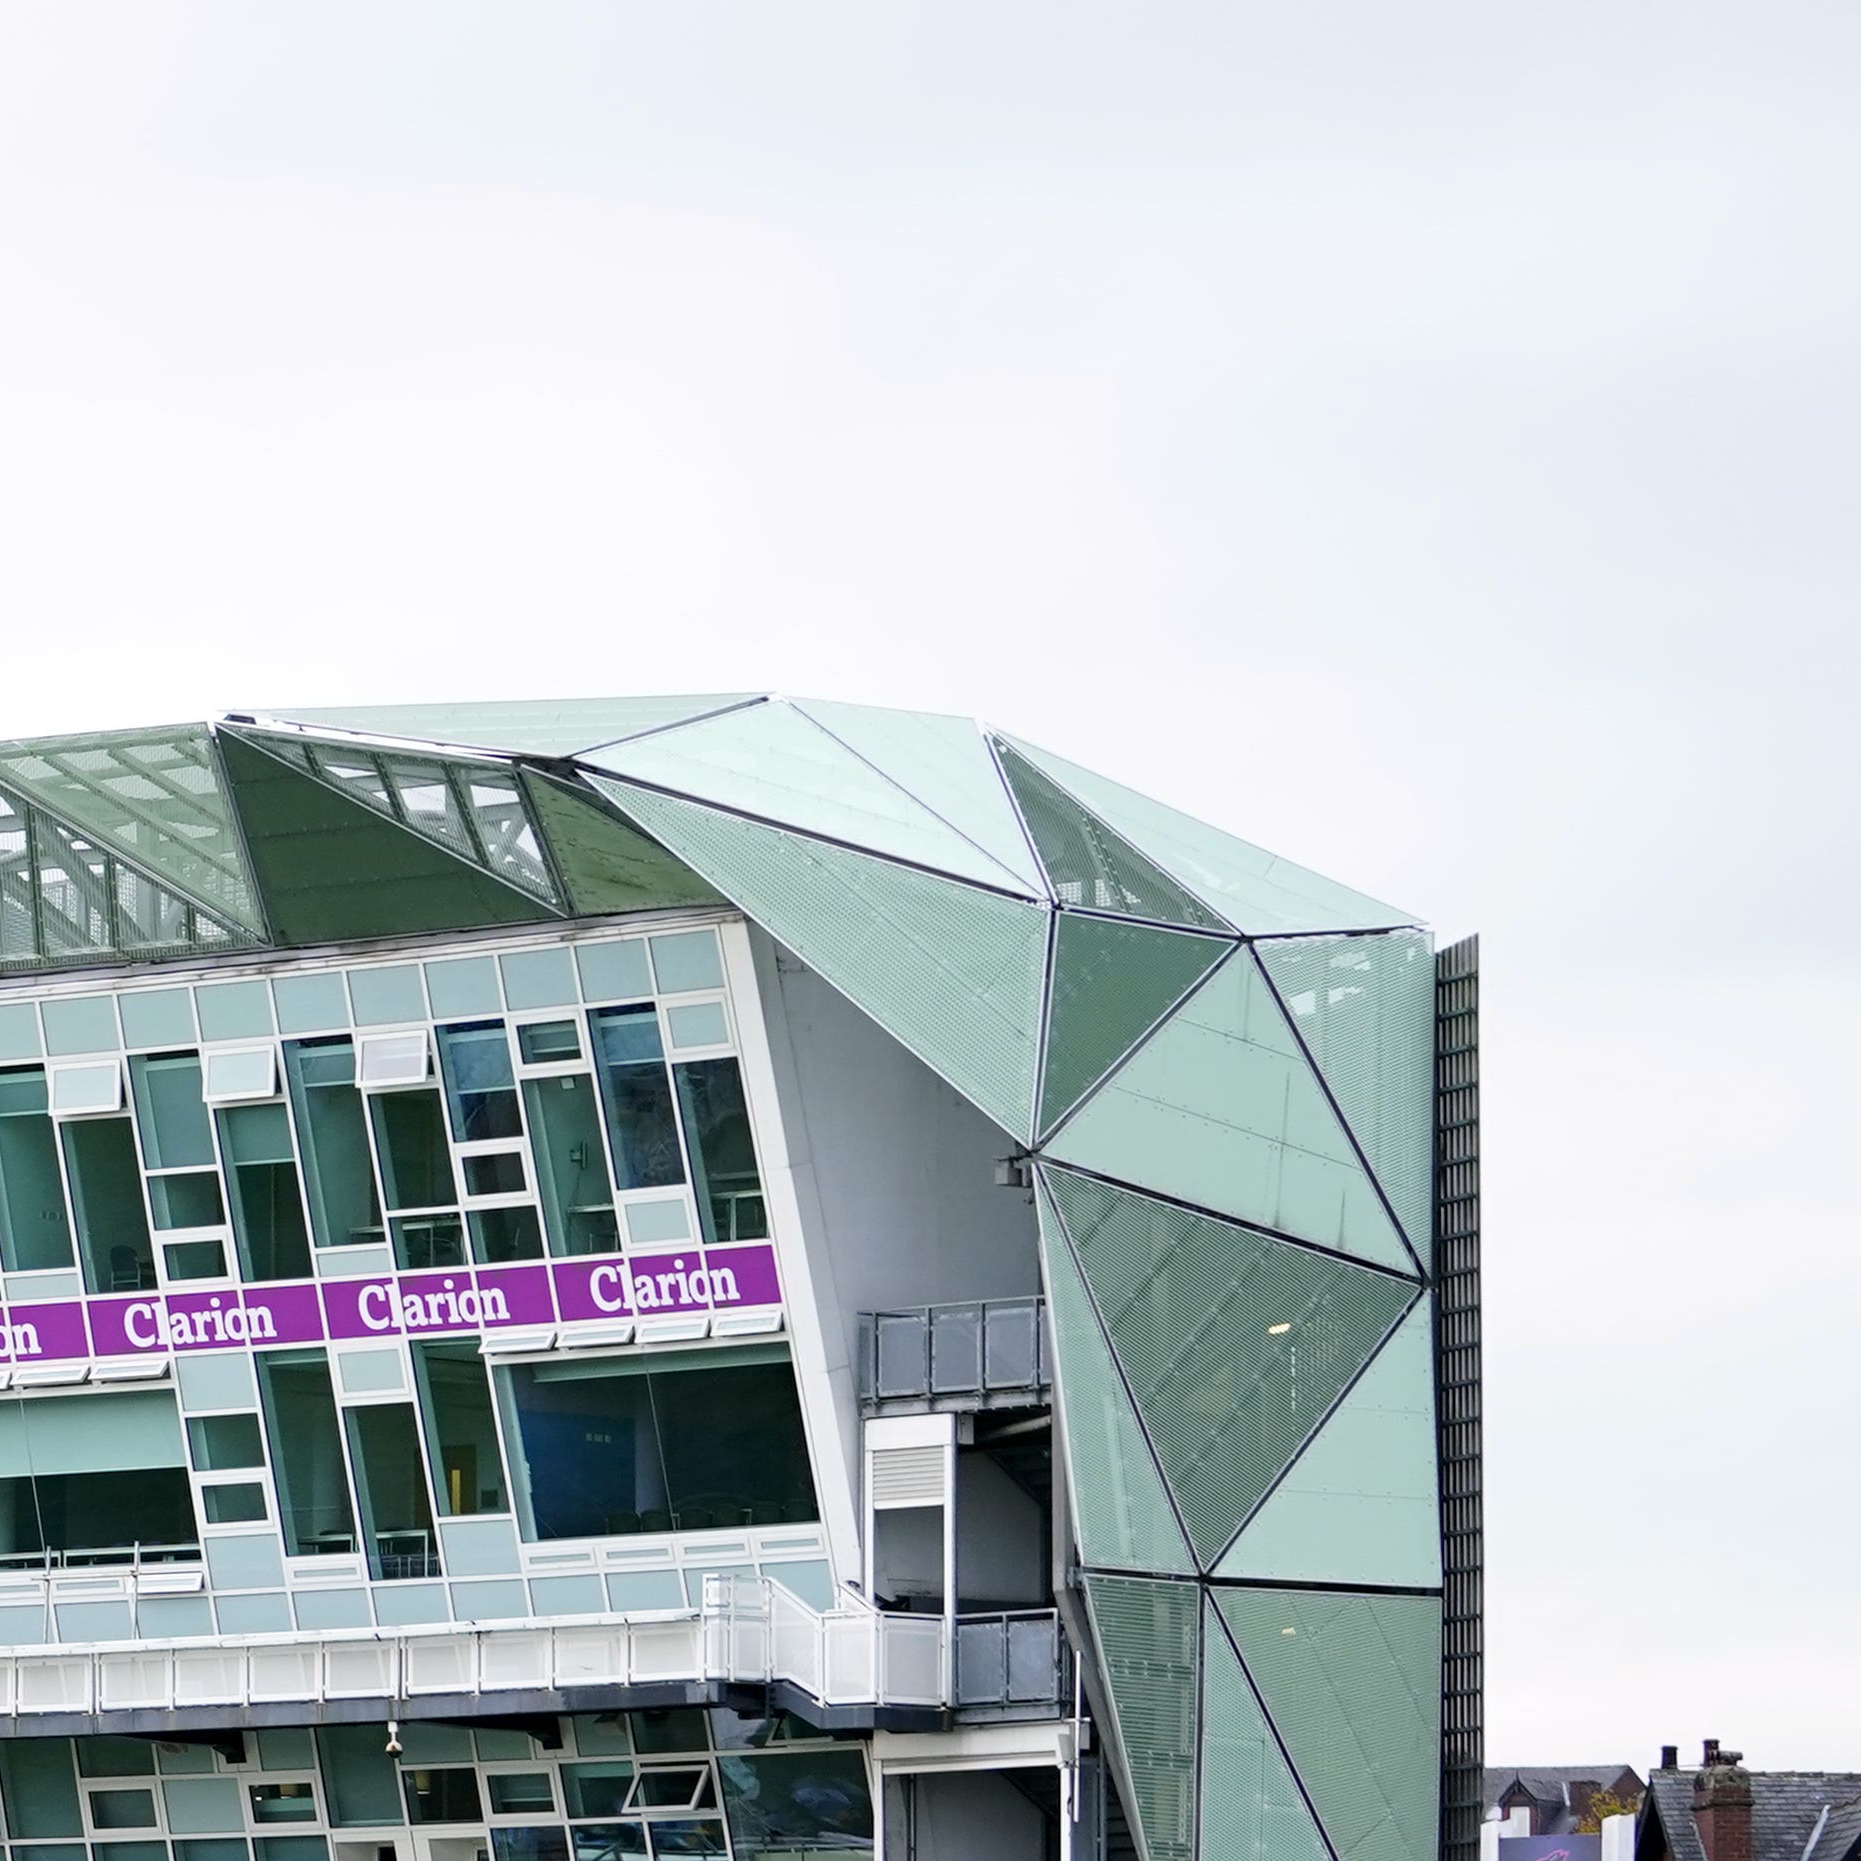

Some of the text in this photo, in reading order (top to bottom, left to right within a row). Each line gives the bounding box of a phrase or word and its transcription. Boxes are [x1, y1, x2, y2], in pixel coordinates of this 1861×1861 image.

[358, 1281, 511, 1329] Clarion
[590, 1259, 741, 1311] Clarion
[123, 1299, 276, 1347] Clarion
